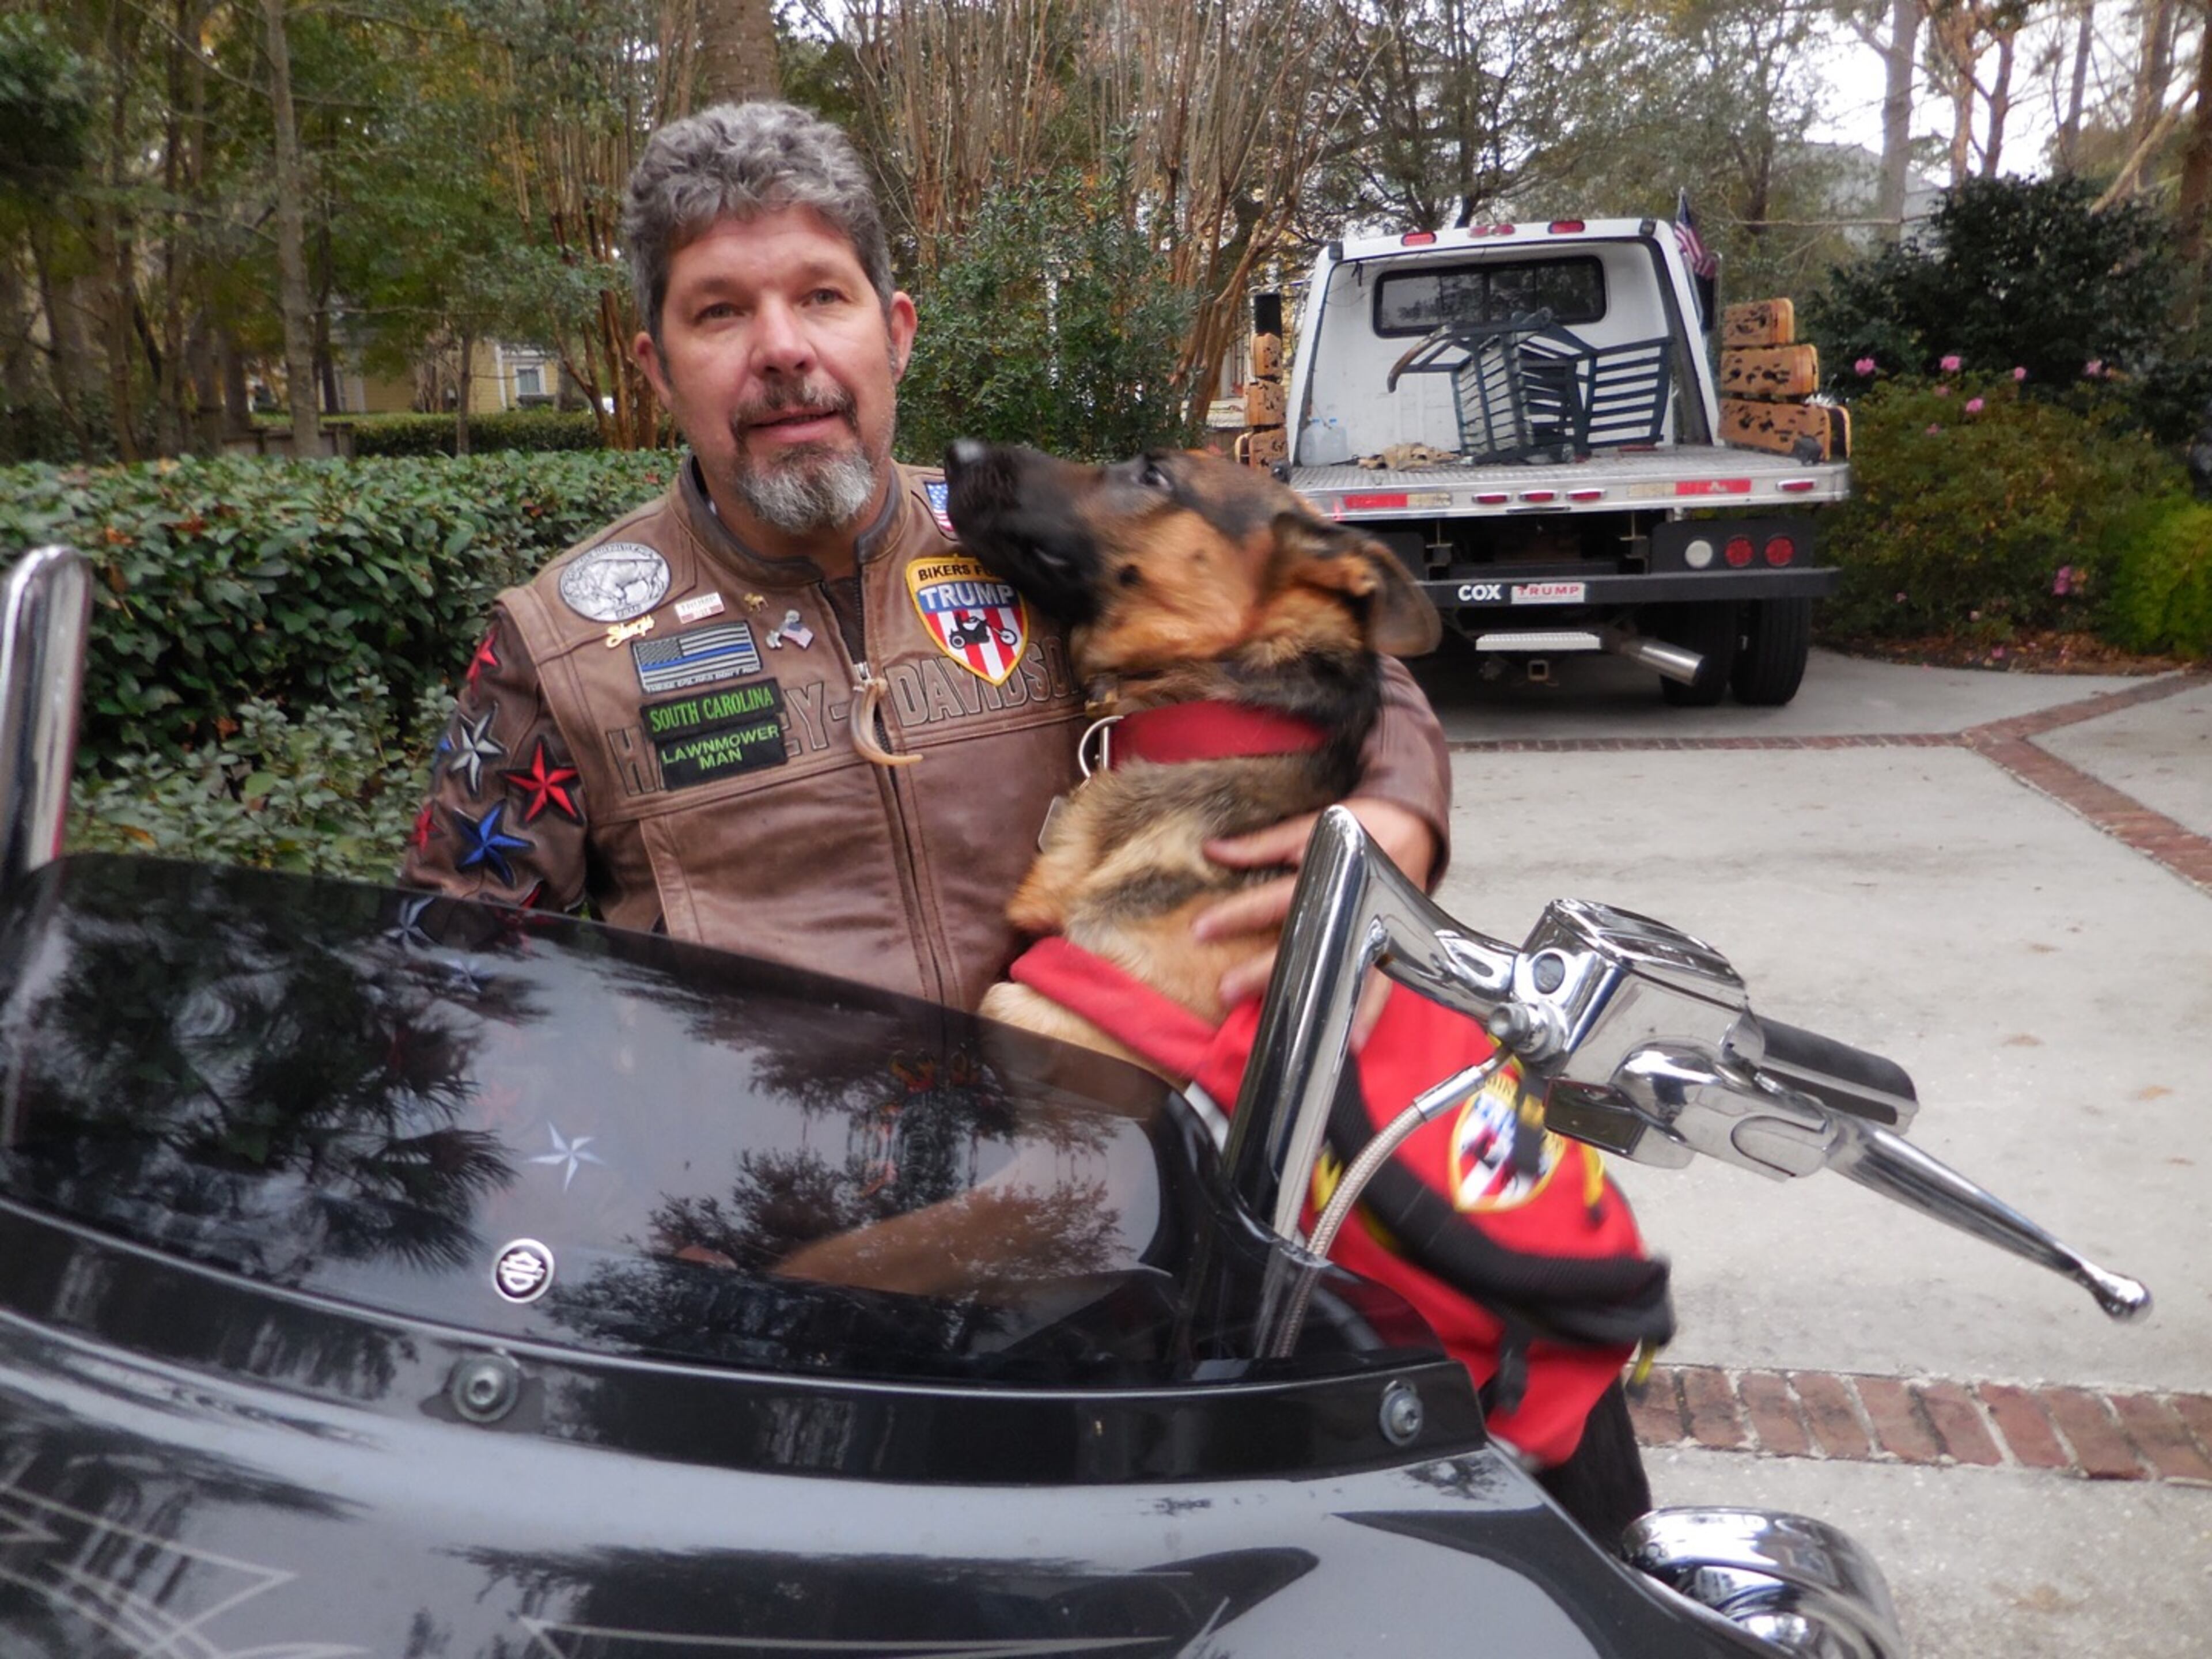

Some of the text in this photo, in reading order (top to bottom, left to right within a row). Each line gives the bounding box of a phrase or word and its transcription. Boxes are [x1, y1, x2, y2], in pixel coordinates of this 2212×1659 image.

[918, 565, 971, 581] BIKERS
[920, 582, 1014, 609] TRUMP
[1458, 584, 1501, 601] COX
[1517, 585, 1580, 596] TRUMP
[650, 686, 774, 732] SOUTH CAROLINA
[661, 724, 779, 764] LAWNMOWER
[699, 748, 743, 770] MAN
